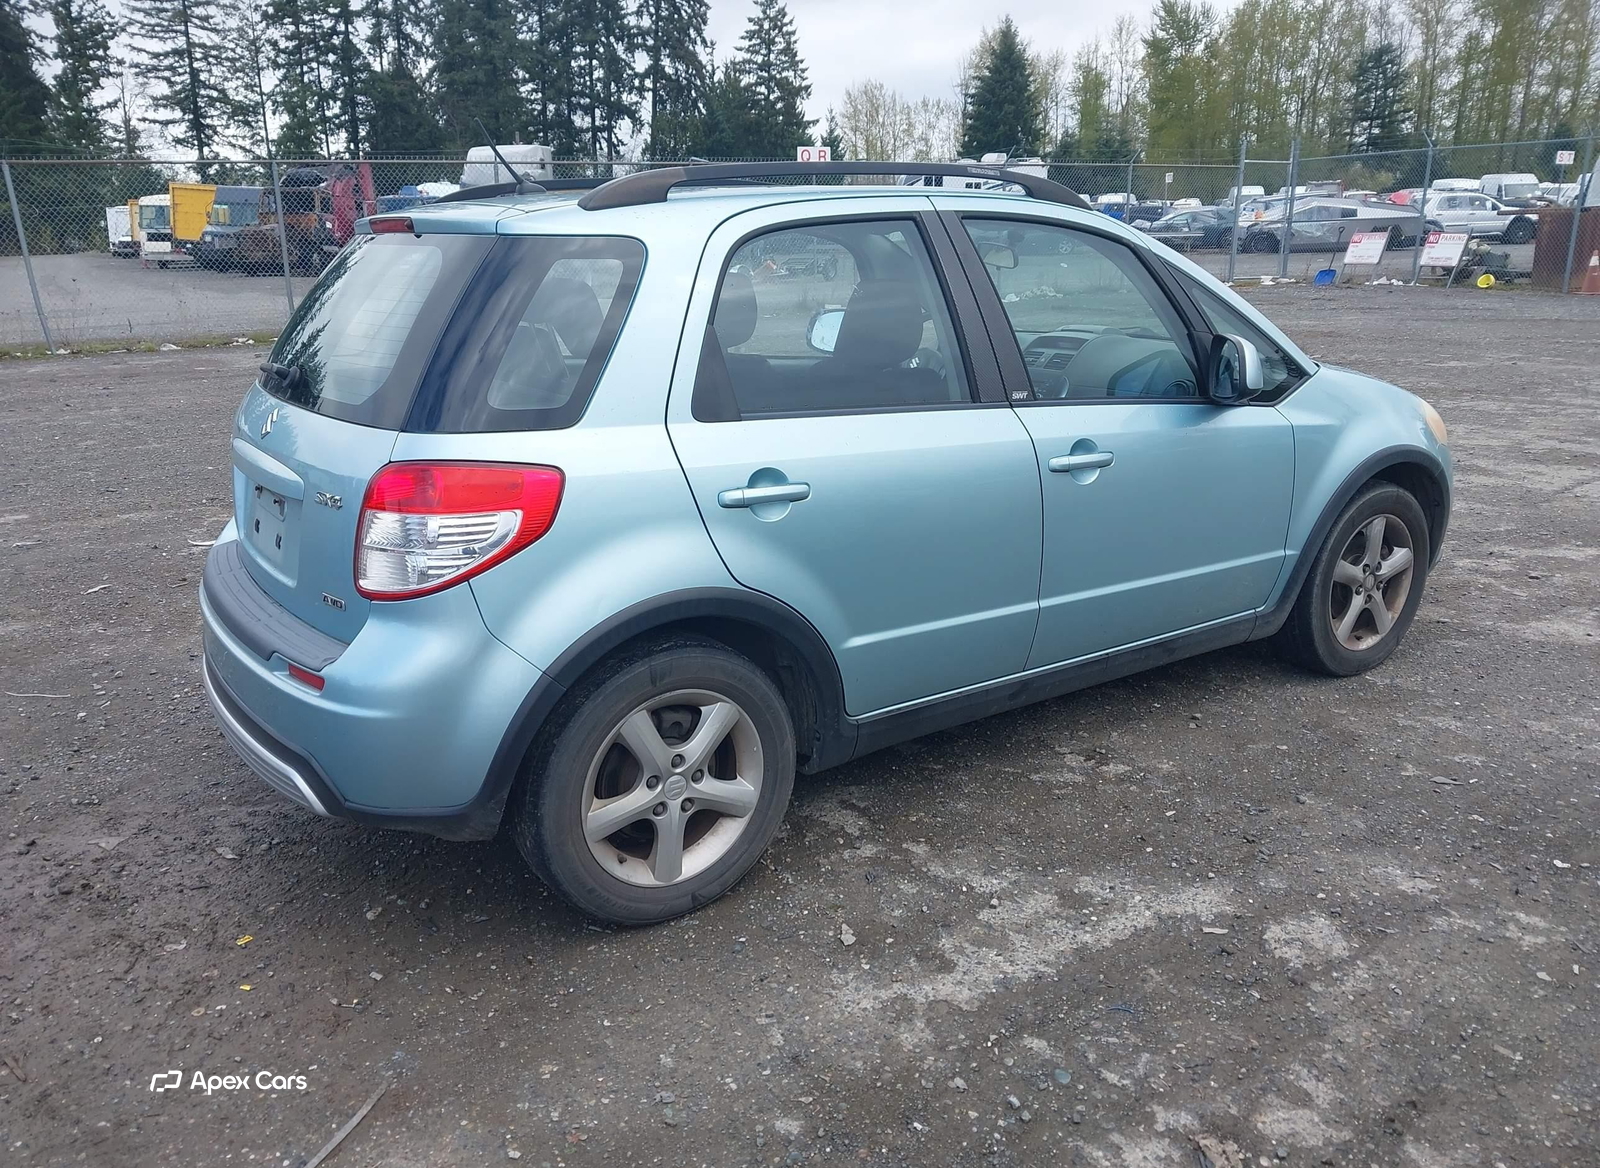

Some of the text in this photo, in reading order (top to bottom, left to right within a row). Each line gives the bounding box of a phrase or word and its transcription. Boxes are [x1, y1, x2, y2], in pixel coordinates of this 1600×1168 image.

[800, 149, 827, 162] Q R
[1428, 234, 1439, 243] NO
[314, 490, 344, 511] SX4
